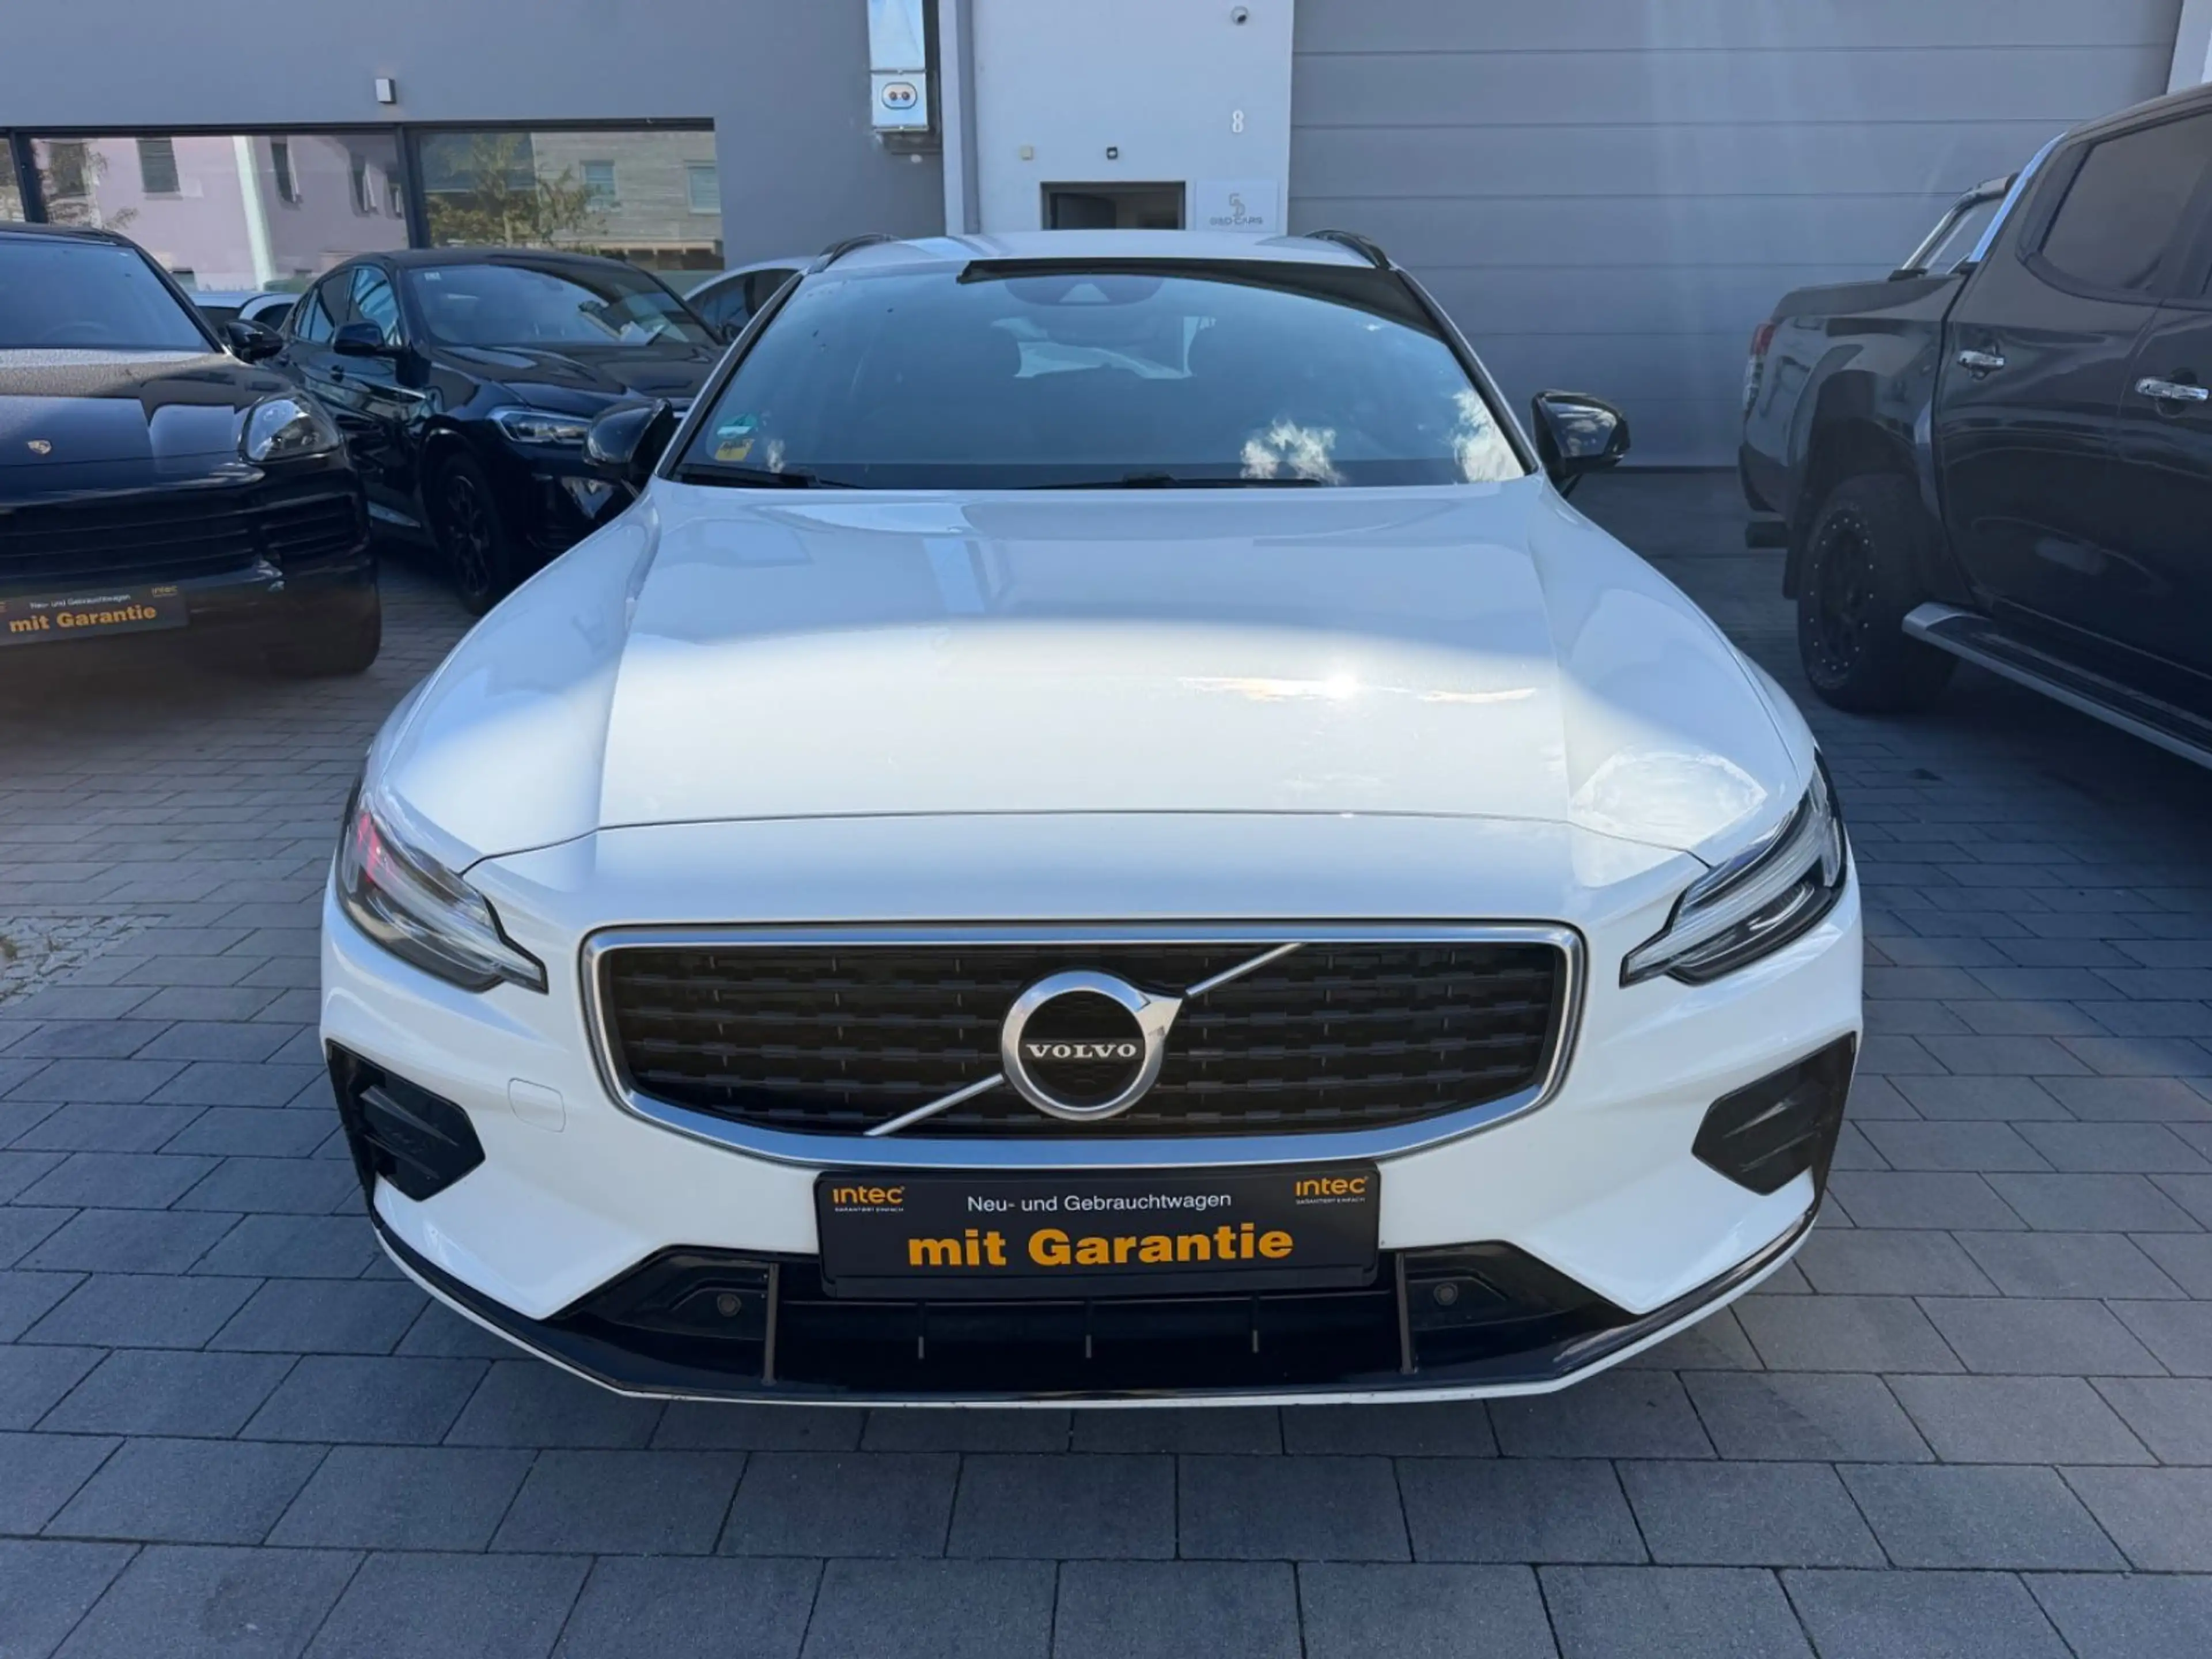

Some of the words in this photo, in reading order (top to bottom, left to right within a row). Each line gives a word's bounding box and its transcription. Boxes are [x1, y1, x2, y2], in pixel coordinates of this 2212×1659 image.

[1232, 109, 1244, 133] 8
[9, 615, 50, 633] mit
[56, 604, 157, 628] Garantie
[1026, 1043, 1137, 1059] VOLVO
[833, 1185, 904, 1204] intec
[1296, 1177, 1366, 1196] intec
[967, 1196, 1015, 1211] Neu-
[1021, 1195, 1057, 1211] und
[1064, 1194, 1232, 1211] Gebrauchtwagen
[908, 1228, 1006, 1266] mit
[1028, 1222, 1294, 1266] Garantie
